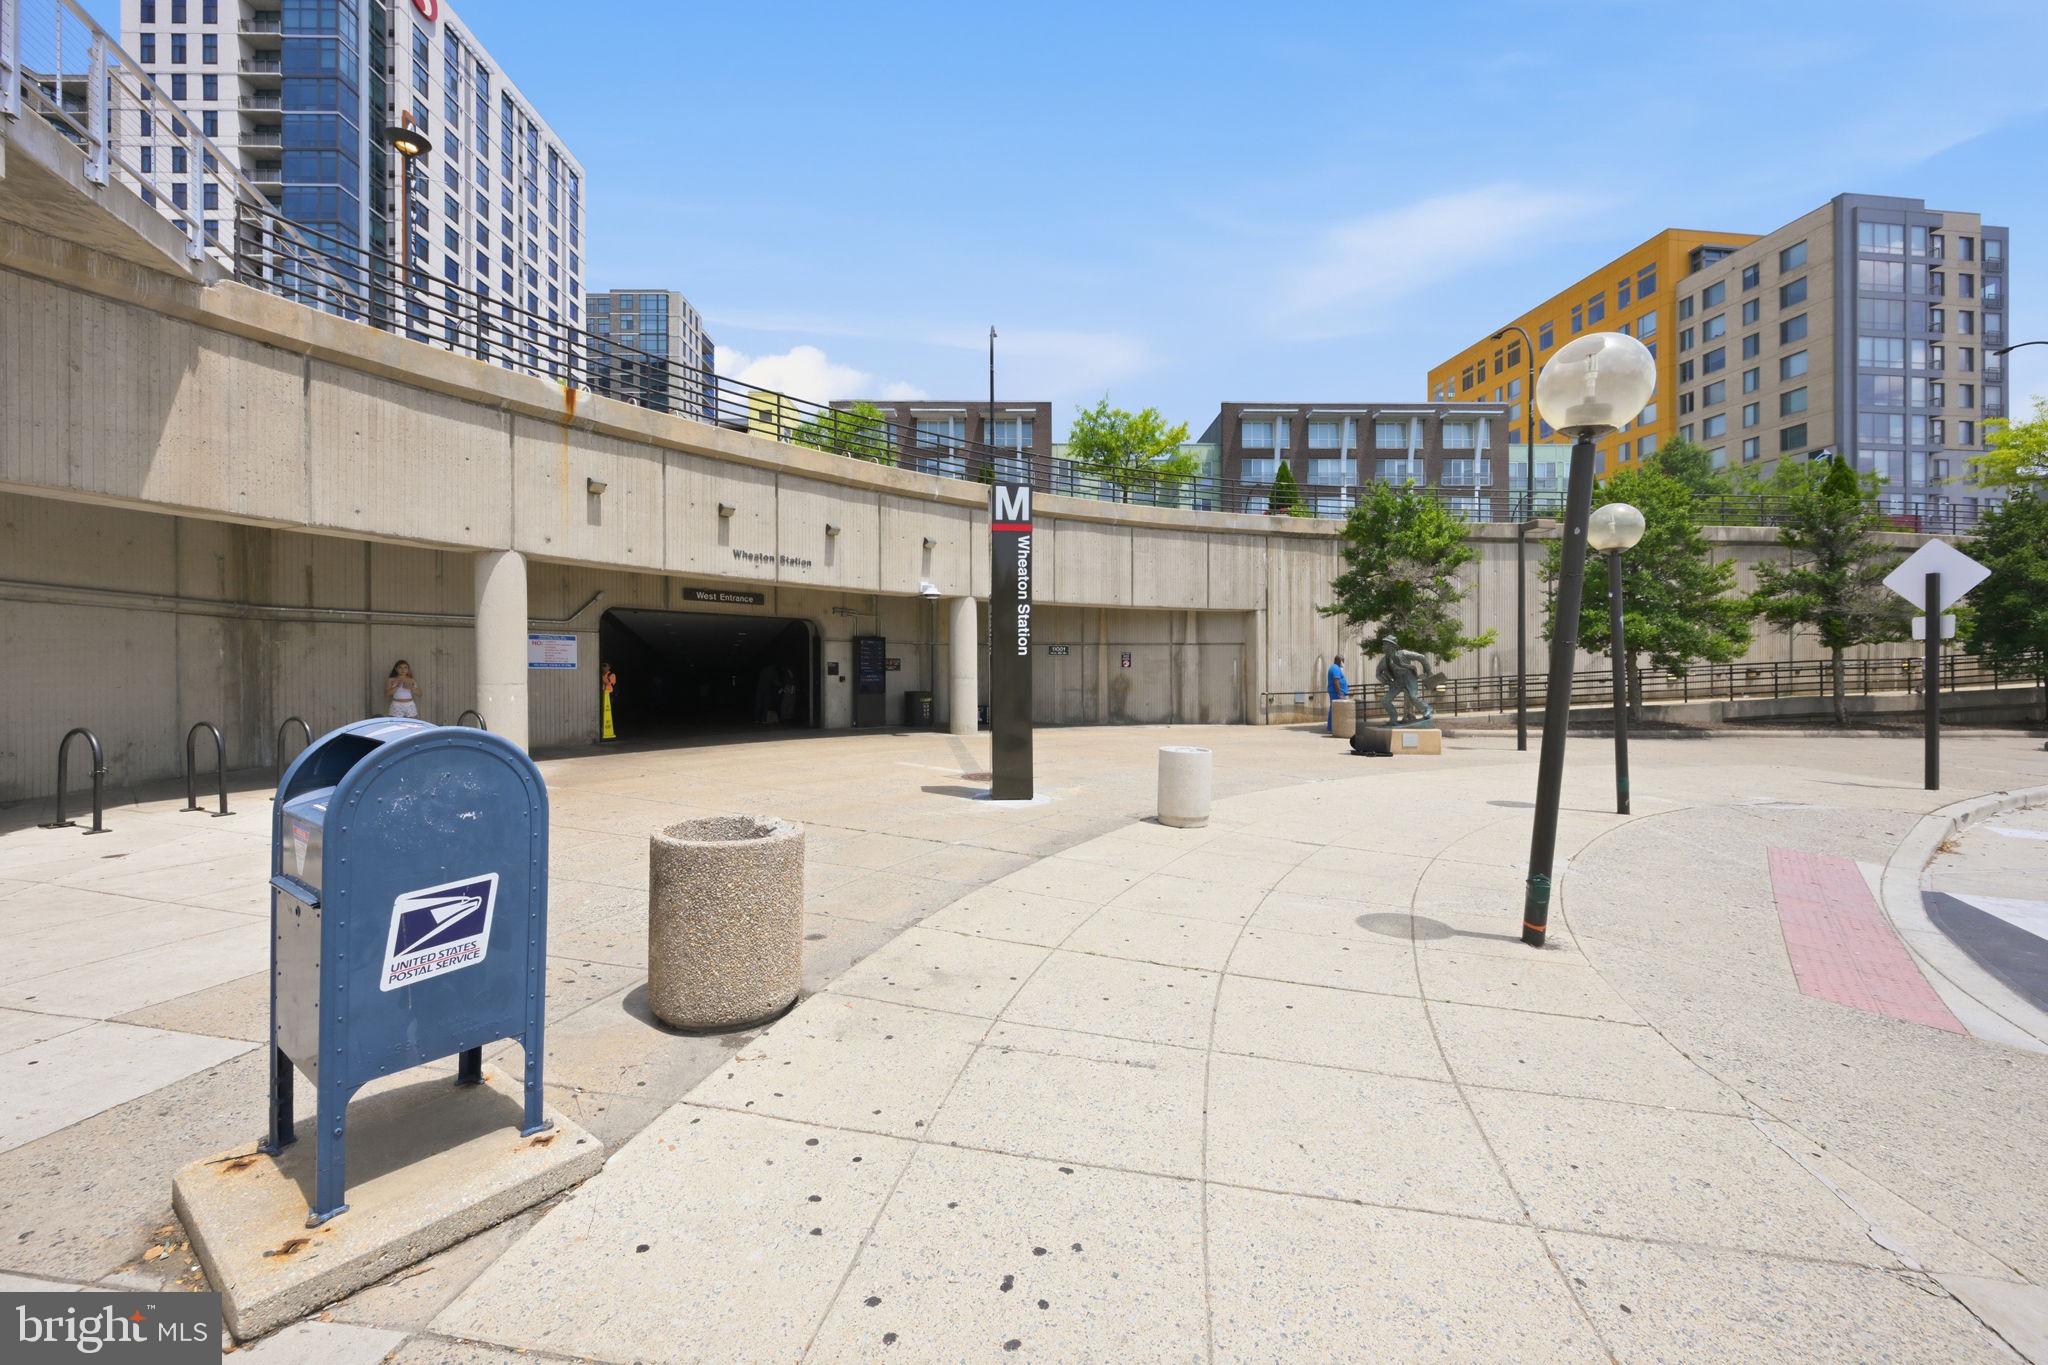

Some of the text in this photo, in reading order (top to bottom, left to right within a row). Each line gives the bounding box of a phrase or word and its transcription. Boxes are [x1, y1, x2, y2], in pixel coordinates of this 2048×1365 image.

[995, 485, 1030, 521] M
[732, 548, 812, 567] Wheaton Station
[696, 591, 754, 603] West Entrance
[1017, 535, 1031, 656] Wheaton Station
[388, 950, 481, 984] POSTAL SERVICE
[390, 940, 478, 973] UNITED STATES
